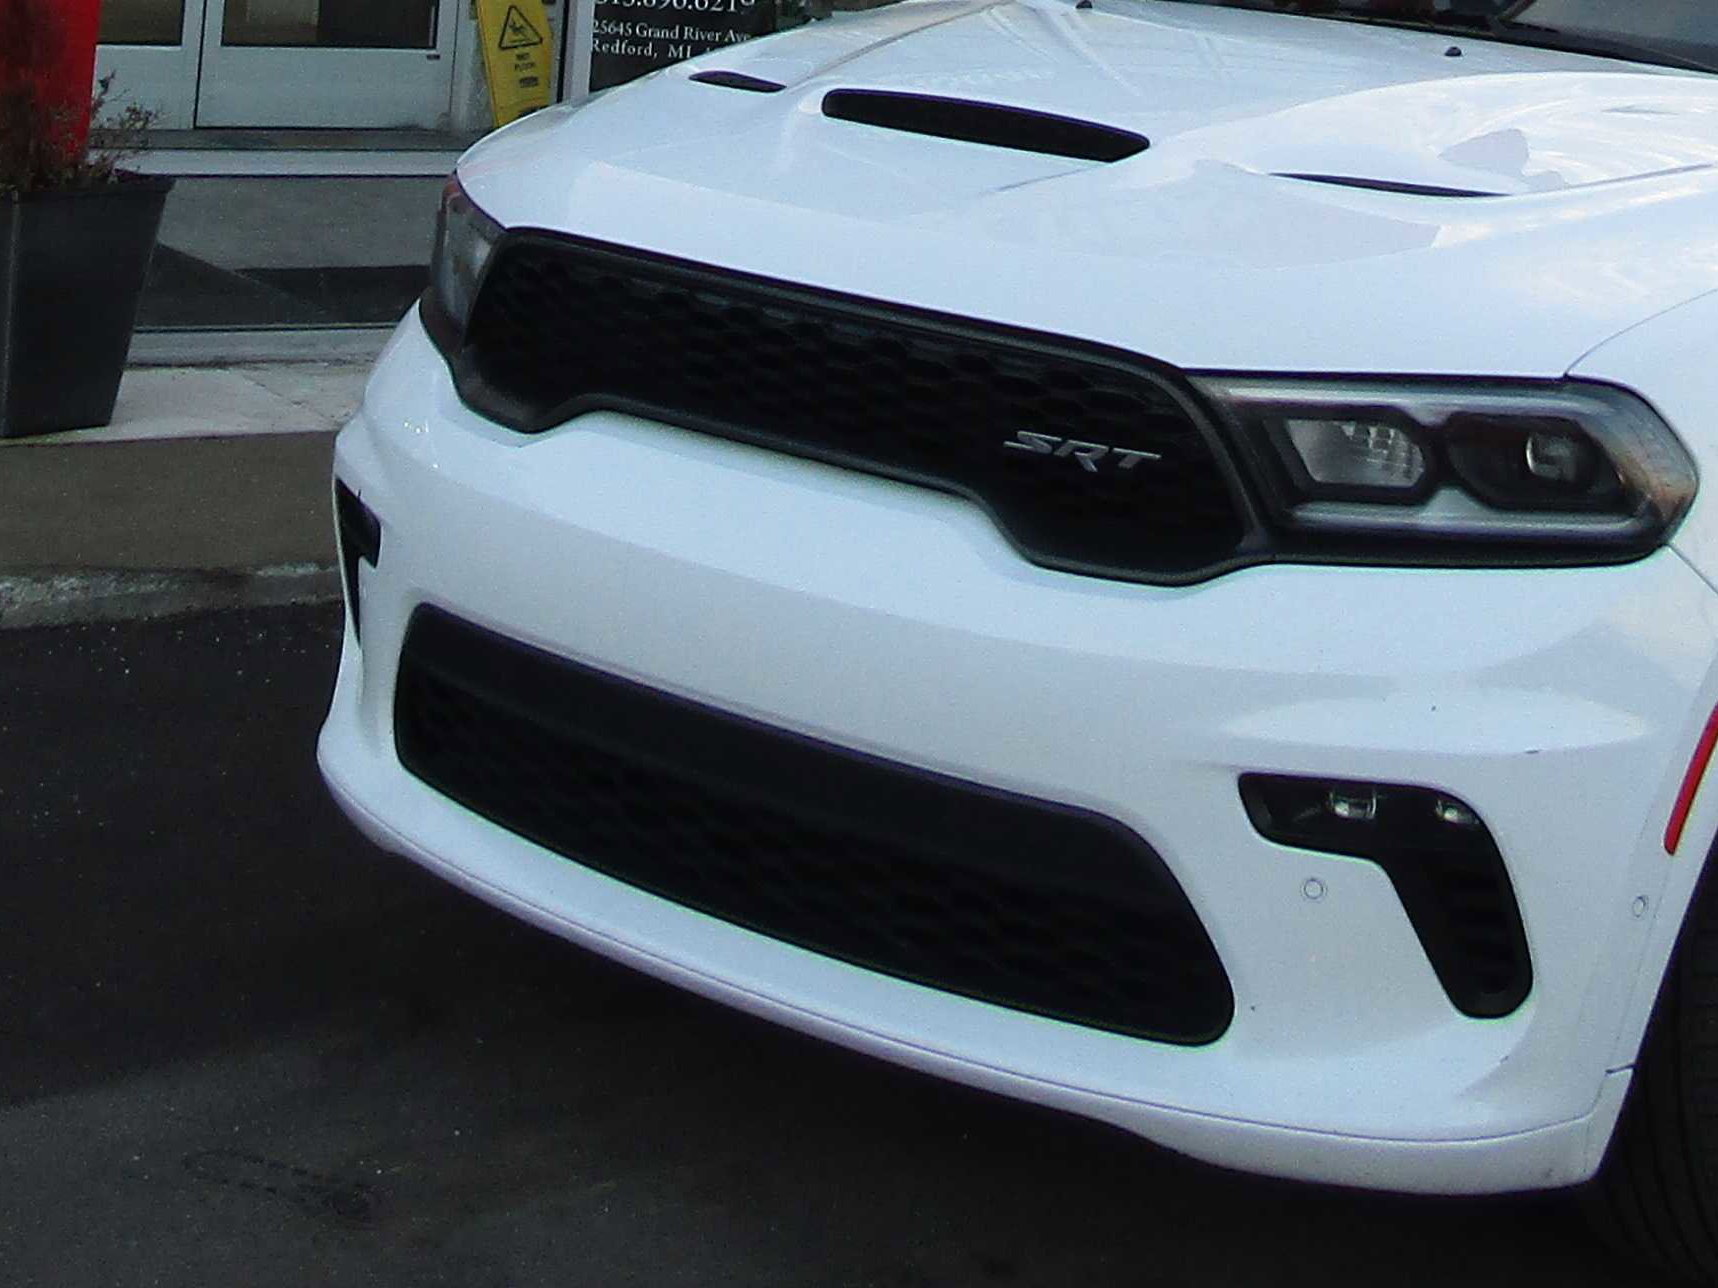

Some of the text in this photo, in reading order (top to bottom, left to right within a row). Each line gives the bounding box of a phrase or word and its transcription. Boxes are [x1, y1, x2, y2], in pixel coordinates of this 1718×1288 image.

[636, 22, 680, 41] Grand
[683, 24, 722, 42] River
[593, 37, 658, 60] Redford,
[668, 43, 692, 59] MI
[1003, 430, 1162, 473] SRT
